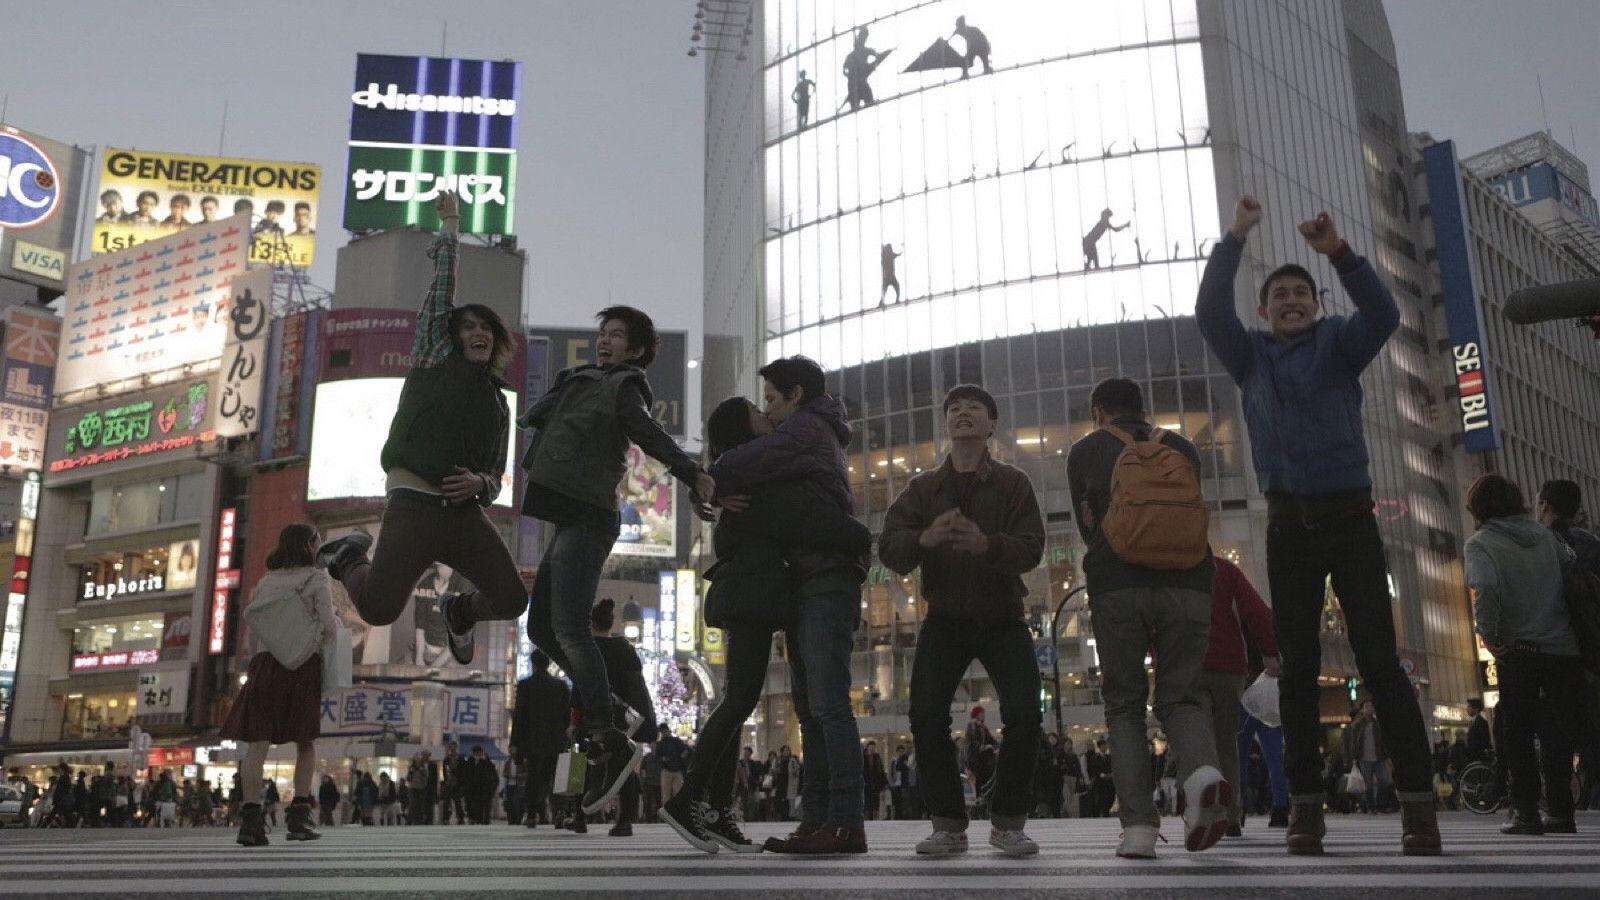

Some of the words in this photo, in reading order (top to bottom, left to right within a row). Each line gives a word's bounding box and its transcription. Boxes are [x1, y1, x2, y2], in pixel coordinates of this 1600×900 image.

[352, 83, 516, 116] Hisamitsu
[107, 152, 317, 191] GENERATIONS
[352, 169, 506, 205] サロンパス
[21, 251, 62, 272] VISA
[220, 288, 265, 428] もんじゃ
[1453, 342, 1489, 433] SEIBU
[84, 576, 163, 600] Euphoria
